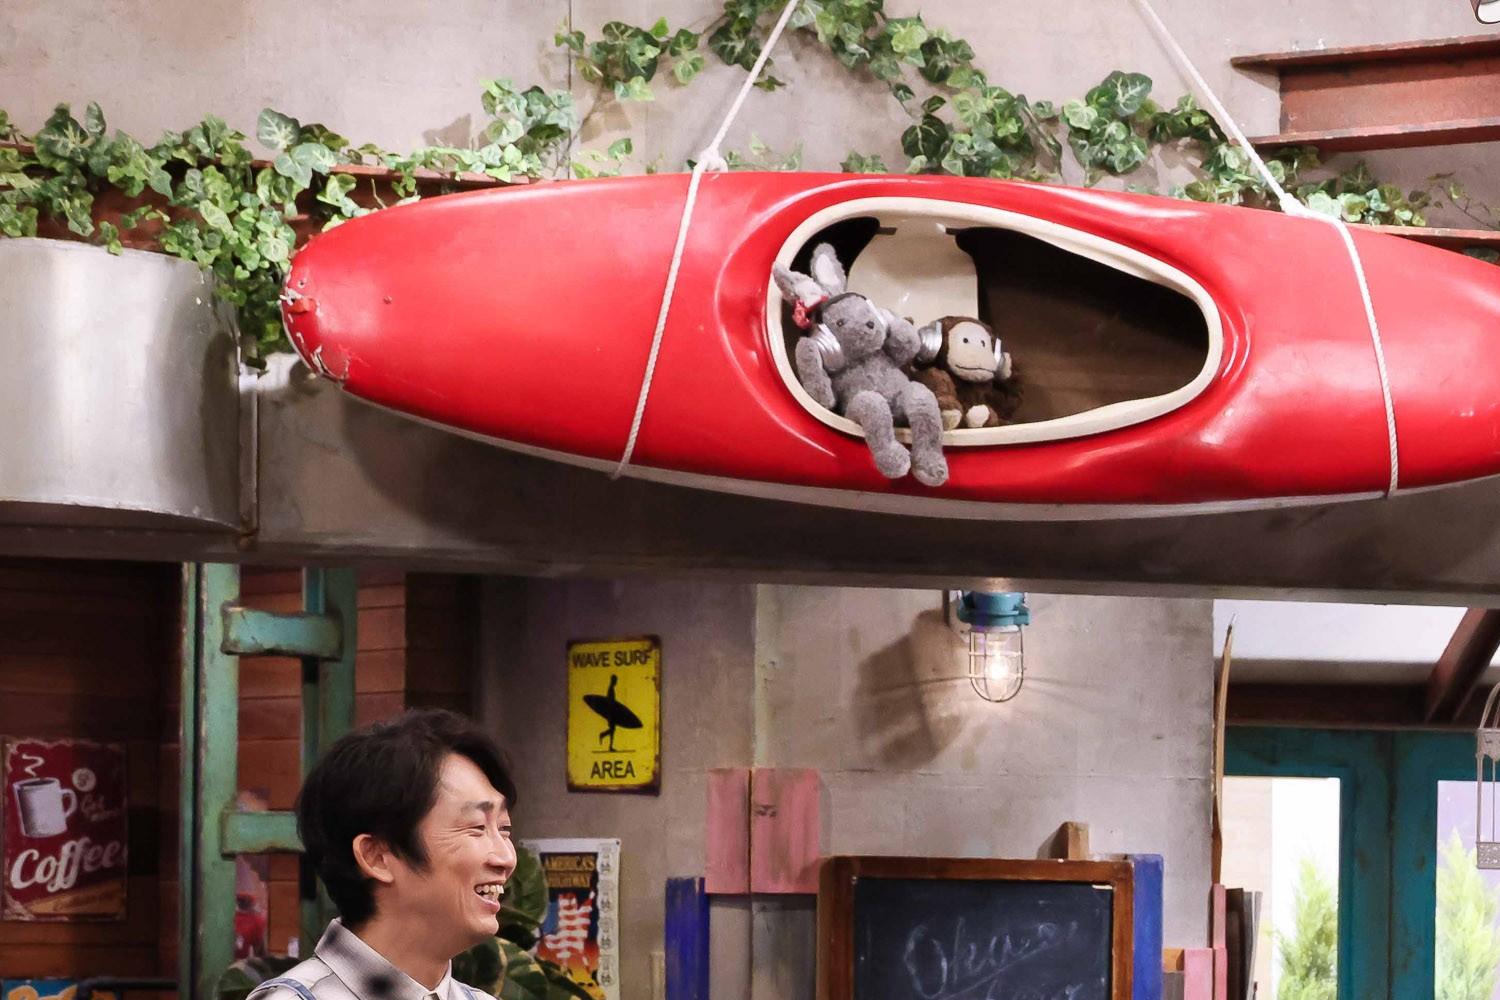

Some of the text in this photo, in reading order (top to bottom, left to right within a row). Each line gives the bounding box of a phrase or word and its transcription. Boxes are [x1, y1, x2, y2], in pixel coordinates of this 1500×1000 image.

[572, 649, 652, 668] WAVE SURF
[591, 761, 636, 778] AREA
[10, 836, 122, 893] Coffee
